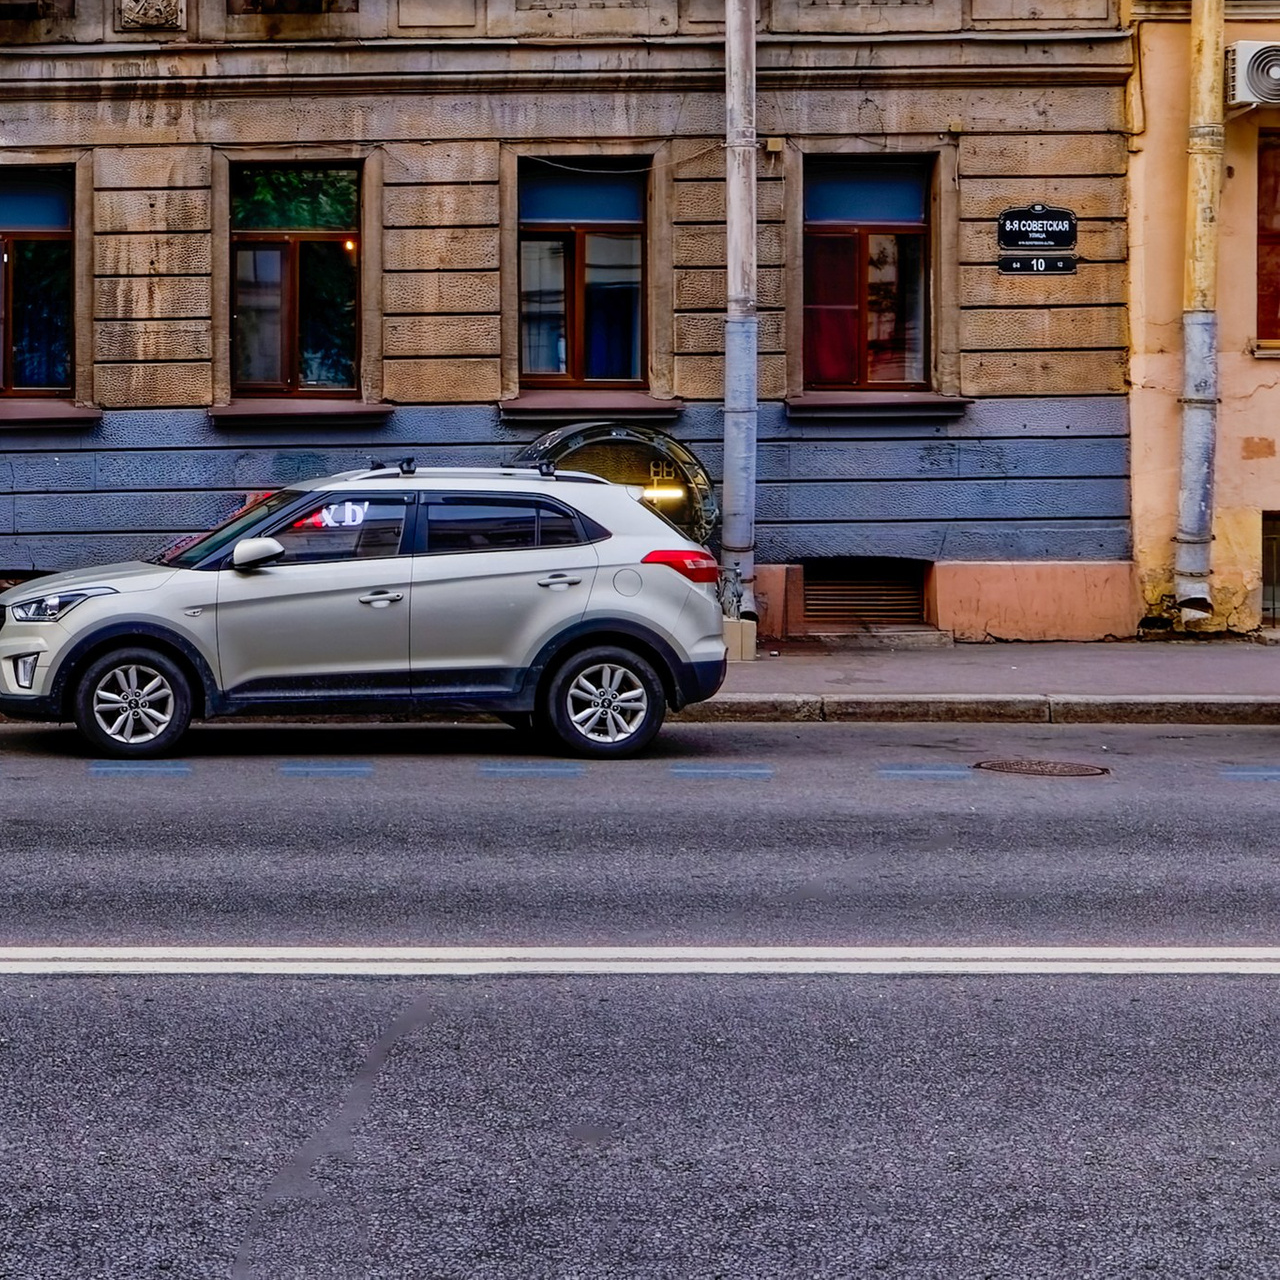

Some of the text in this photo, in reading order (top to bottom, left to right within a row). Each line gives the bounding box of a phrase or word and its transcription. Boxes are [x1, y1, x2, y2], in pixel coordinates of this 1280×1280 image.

[1005, 220, 1069, 231] 8-Я СОВЕТСКАЯ
[1031, 258, 1045, 271] 10
